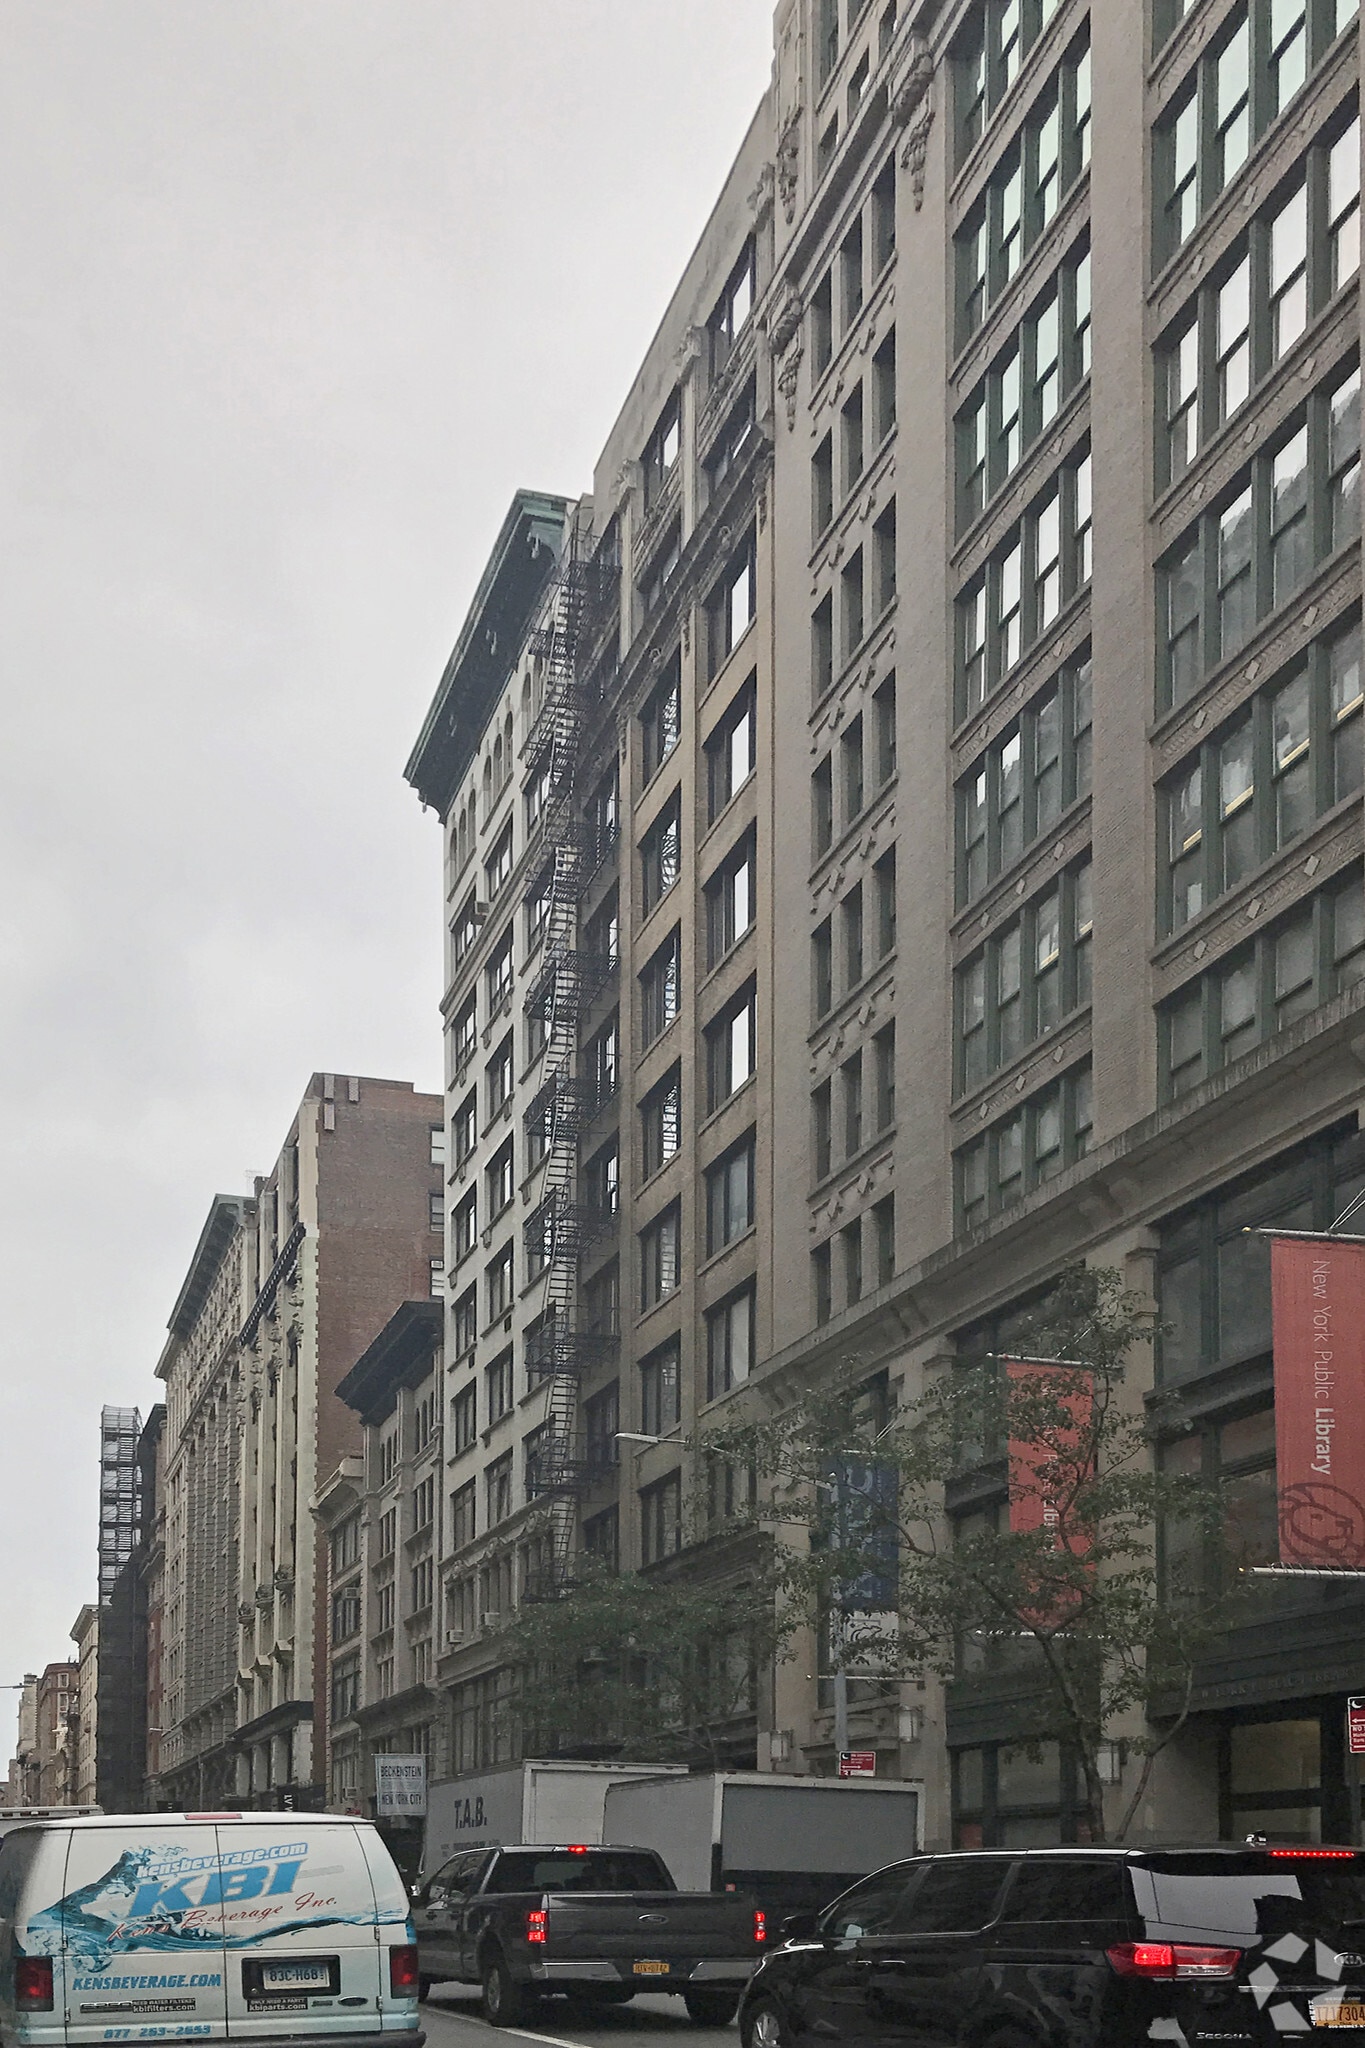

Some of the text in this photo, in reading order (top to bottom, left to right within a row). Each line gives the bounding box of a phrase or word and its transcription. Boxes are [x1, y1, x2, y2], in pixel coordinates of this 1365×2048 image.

[1311, 1260, 1336, 1475] New York Public Library
[381, 1766, 422, 1777] BECKENSTEIN
[454, 1796, 488, 1829] T.A.B.
[128, 1860, 306, 1917] KBI
[181, 1904, 283, 1929] Beverage
[294, 1891, 337, 1911] Inc.
[1340, 1954, 1363, 1965] KIA
[72, 1974, 222, 1990] KENSBEVERAGE.COM
[249, 2003, 306, 2012] kbiparts.com
[104, 2029, 130, 2039] 877
